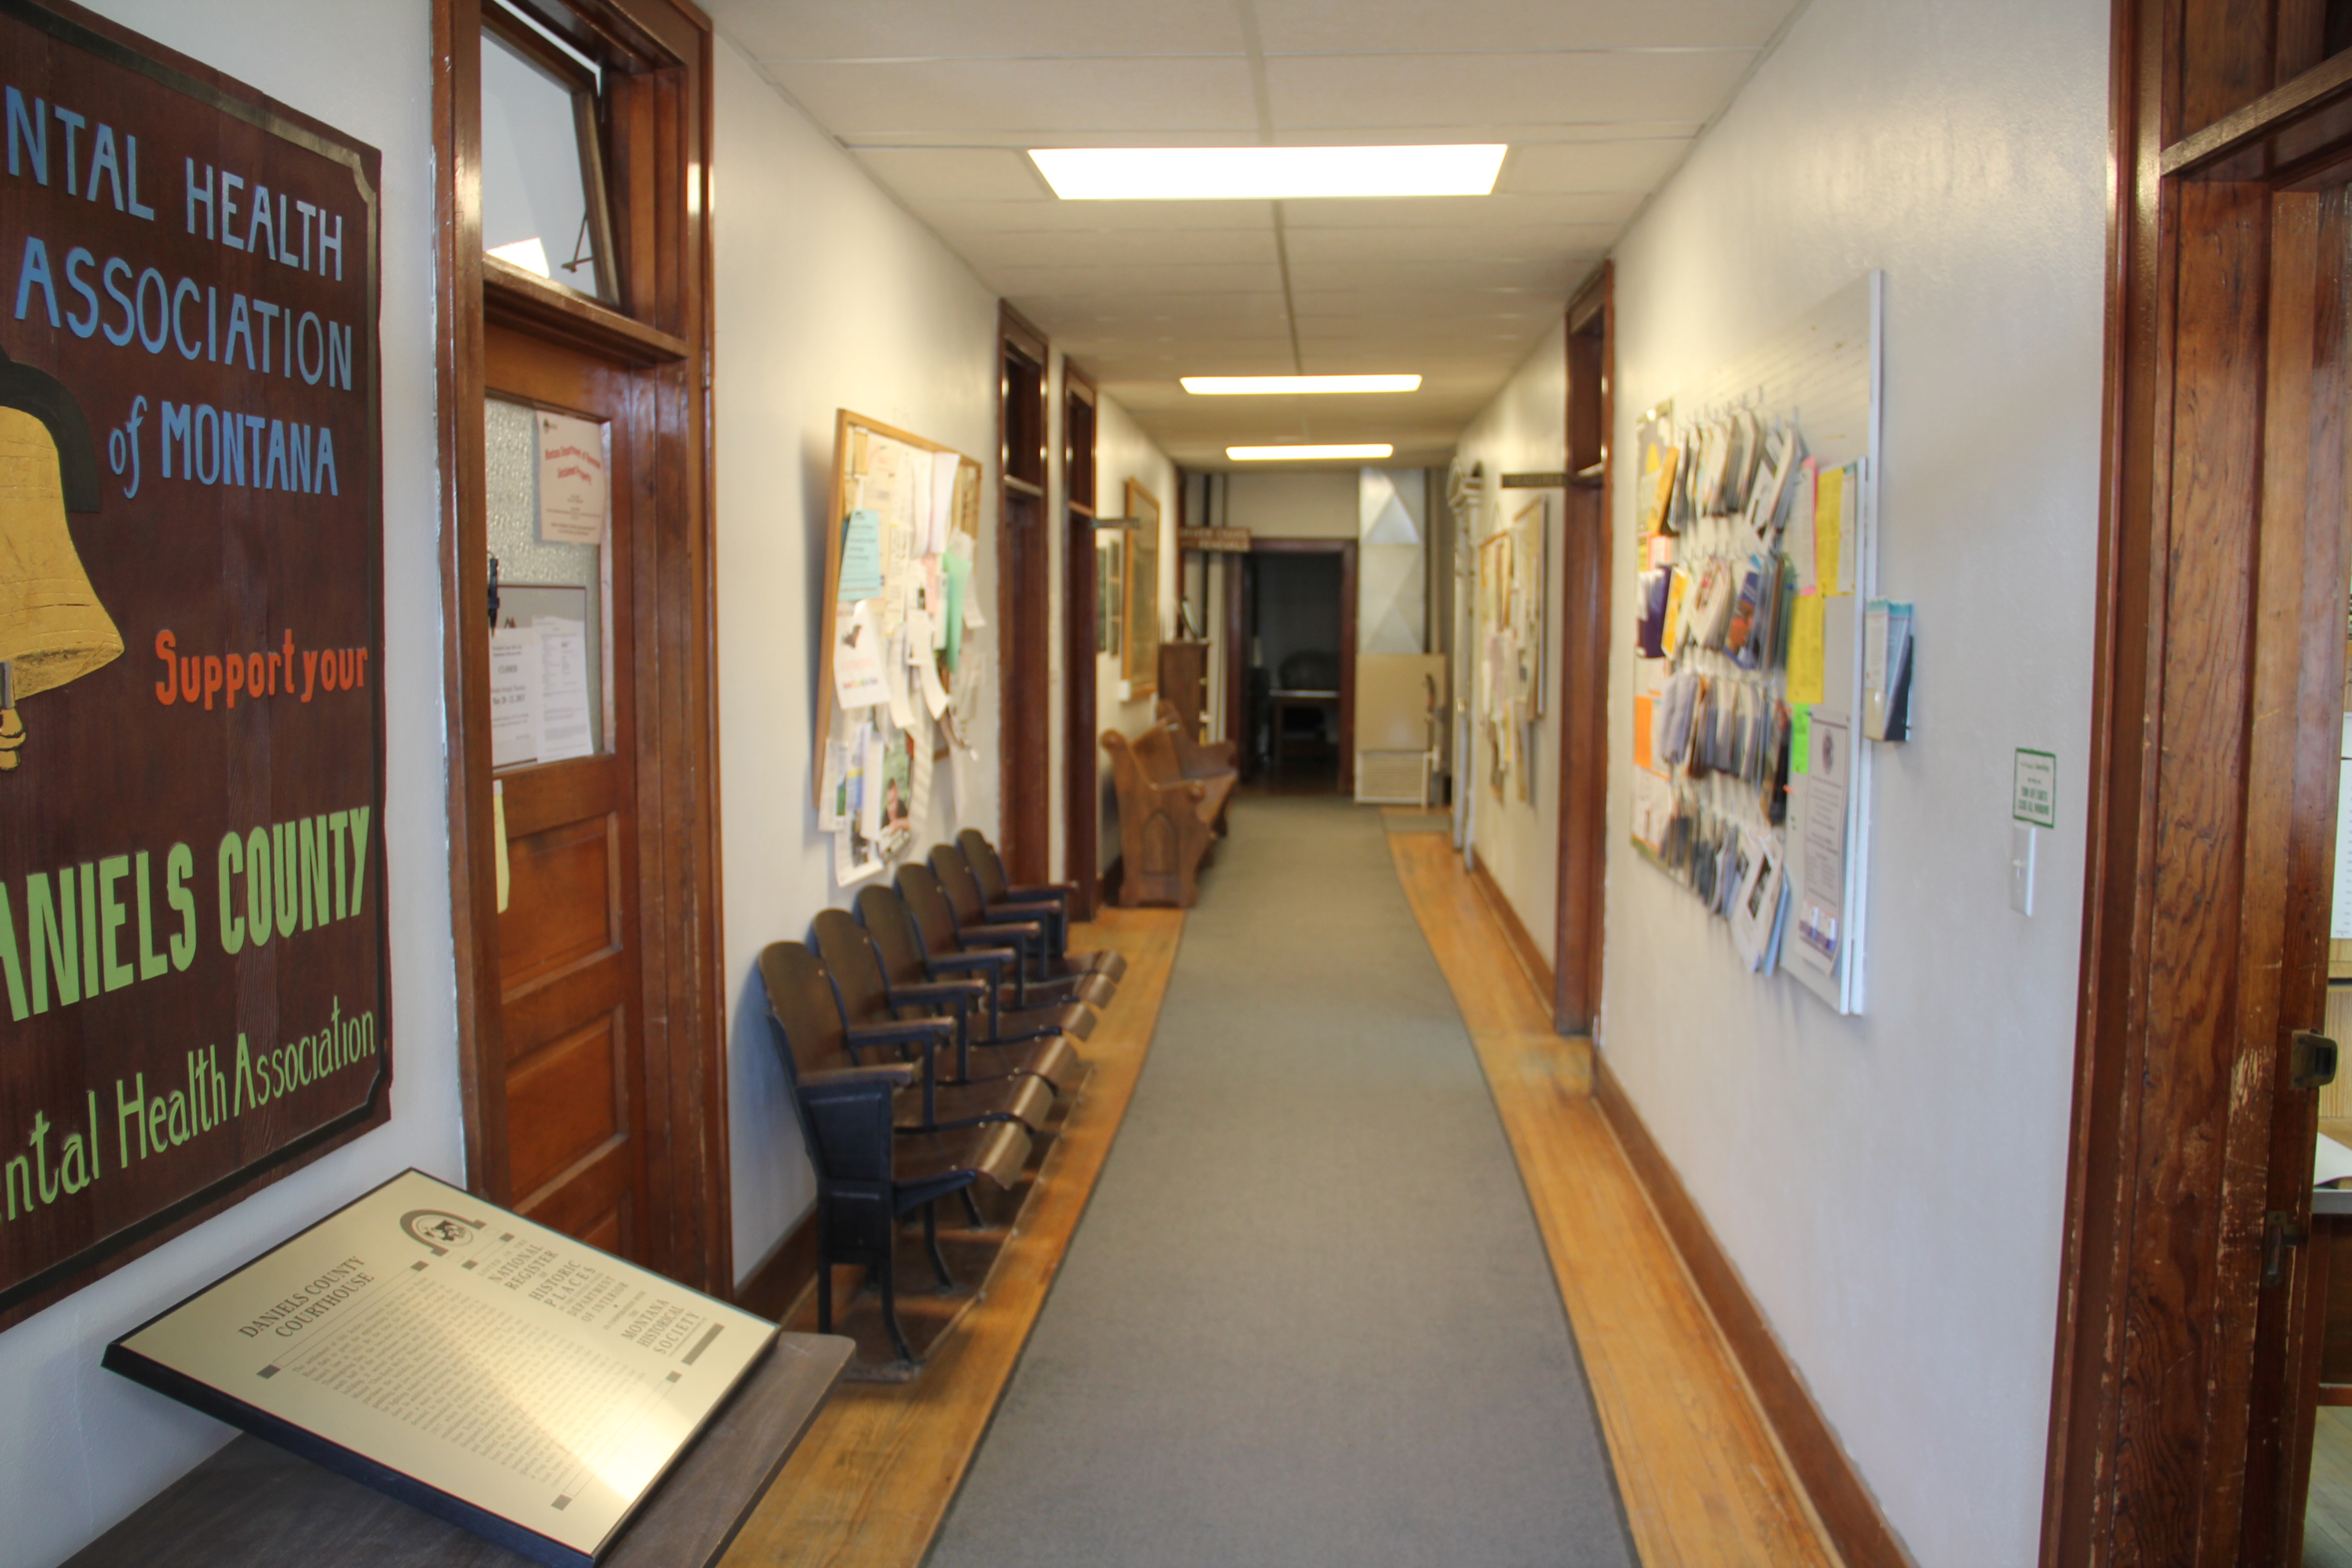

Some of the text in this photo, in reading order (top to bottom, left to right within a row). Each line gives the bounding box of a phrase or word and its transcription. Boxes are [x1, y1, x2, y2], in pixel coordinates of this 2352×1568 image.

[186, 157, 342, 281] HEALTH
[15, 237, 350, 389] ASSOCIATION
[110, 396, 338, 498] of MONTANA
[156, 630, 367, 710] Support your
[220, 807, 370, 953] COUNTY
[118, 1045, 227, 1167] Health
[235, 996, 375, 1116] Association
[486, 1243, 544, 1283] NATIONAL
[503, 1250, 559, 1290] REGISTER
[527, 1259, 583, 1301] HISTORIC
[543, 1265, 597, 1307] PLACES
[237, 1292, 312, 1338] DANIELS
[301, 1255, 368, 1296] COUNTY
[271, 1272, 376, 1338] COURTHOUSE
[620, 1298, 669, 1340] MONTANA
[635, 1304, 684, 1347] HISTORICAL
[651, 1310, 700, 1355] SOCIETY
